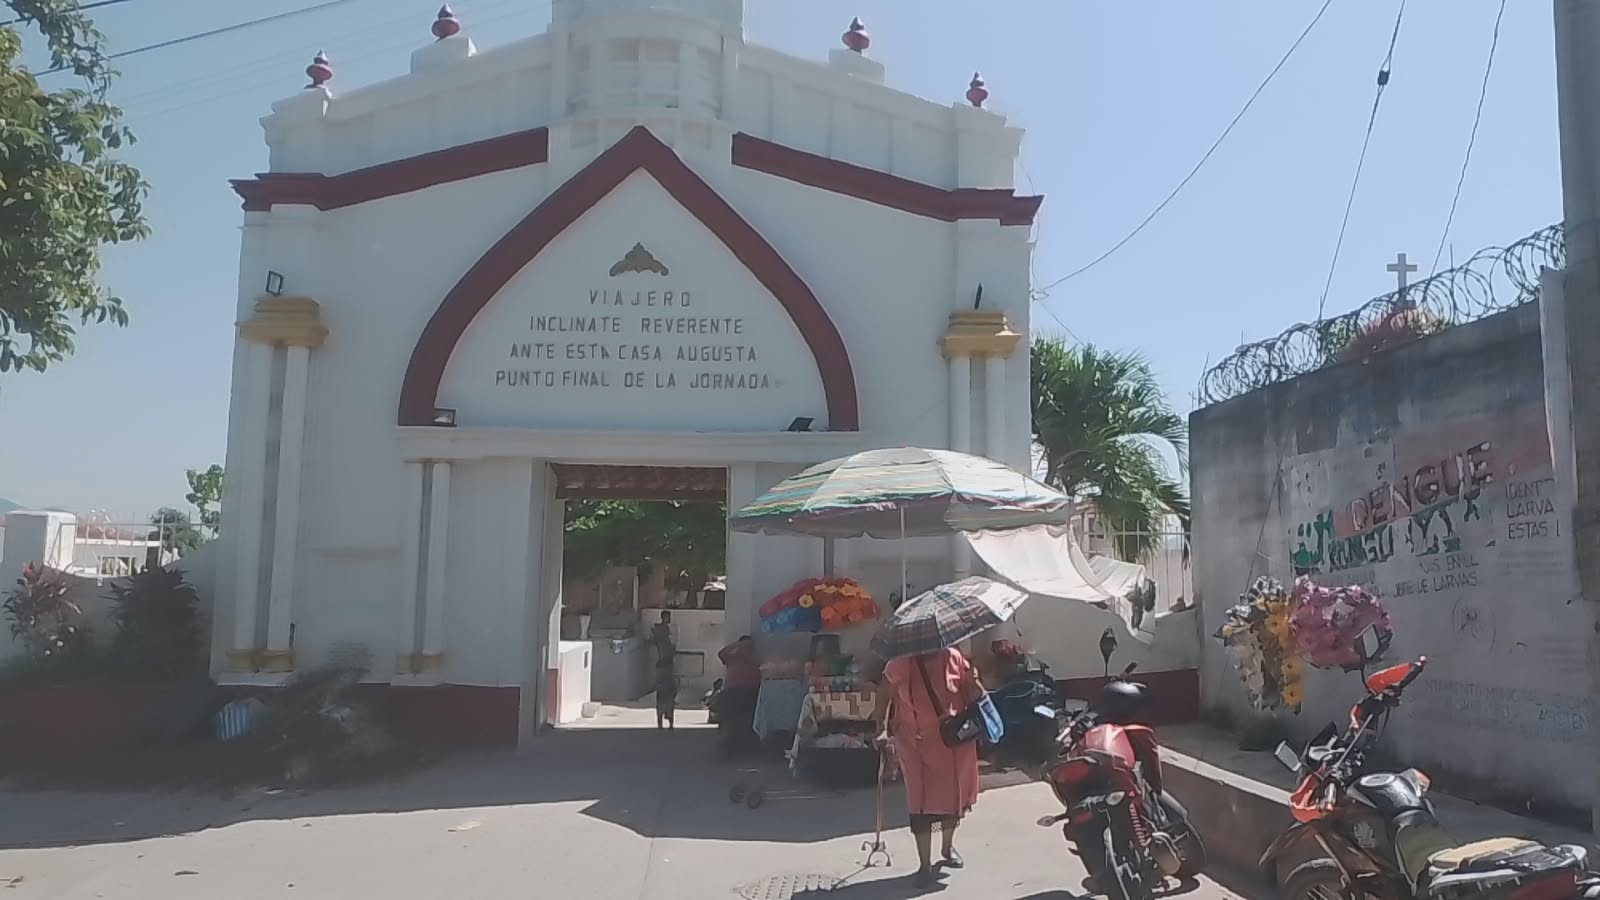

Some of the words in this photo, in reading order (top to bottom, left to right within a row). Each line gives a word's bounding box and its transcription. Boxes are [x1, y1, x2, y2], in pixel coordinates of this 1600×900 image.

[589, 289, 691, 307] VIAJERO
[529, 315, 622, 333] INCLINATE
[641, 317, 744, 335] REVERENTE
[509, 343, 555, 360] ANTE
[566, 344, 610, 361] ESTA
[618, 344, 662, 361] CASA
[676, 345, 757, 362] AUGUSTA
[495, 370, 554, 388] PUNTO
[562, 370, 610, 388] FINAL
[624, 371, 645, 388] DE
[655, 372, 677, 389] LA
[689, 372, 770, 390] JORNADA
[1350, 441, 1493, 531] DENGUE
[1508, 521, 1548, 540] ESTAS
